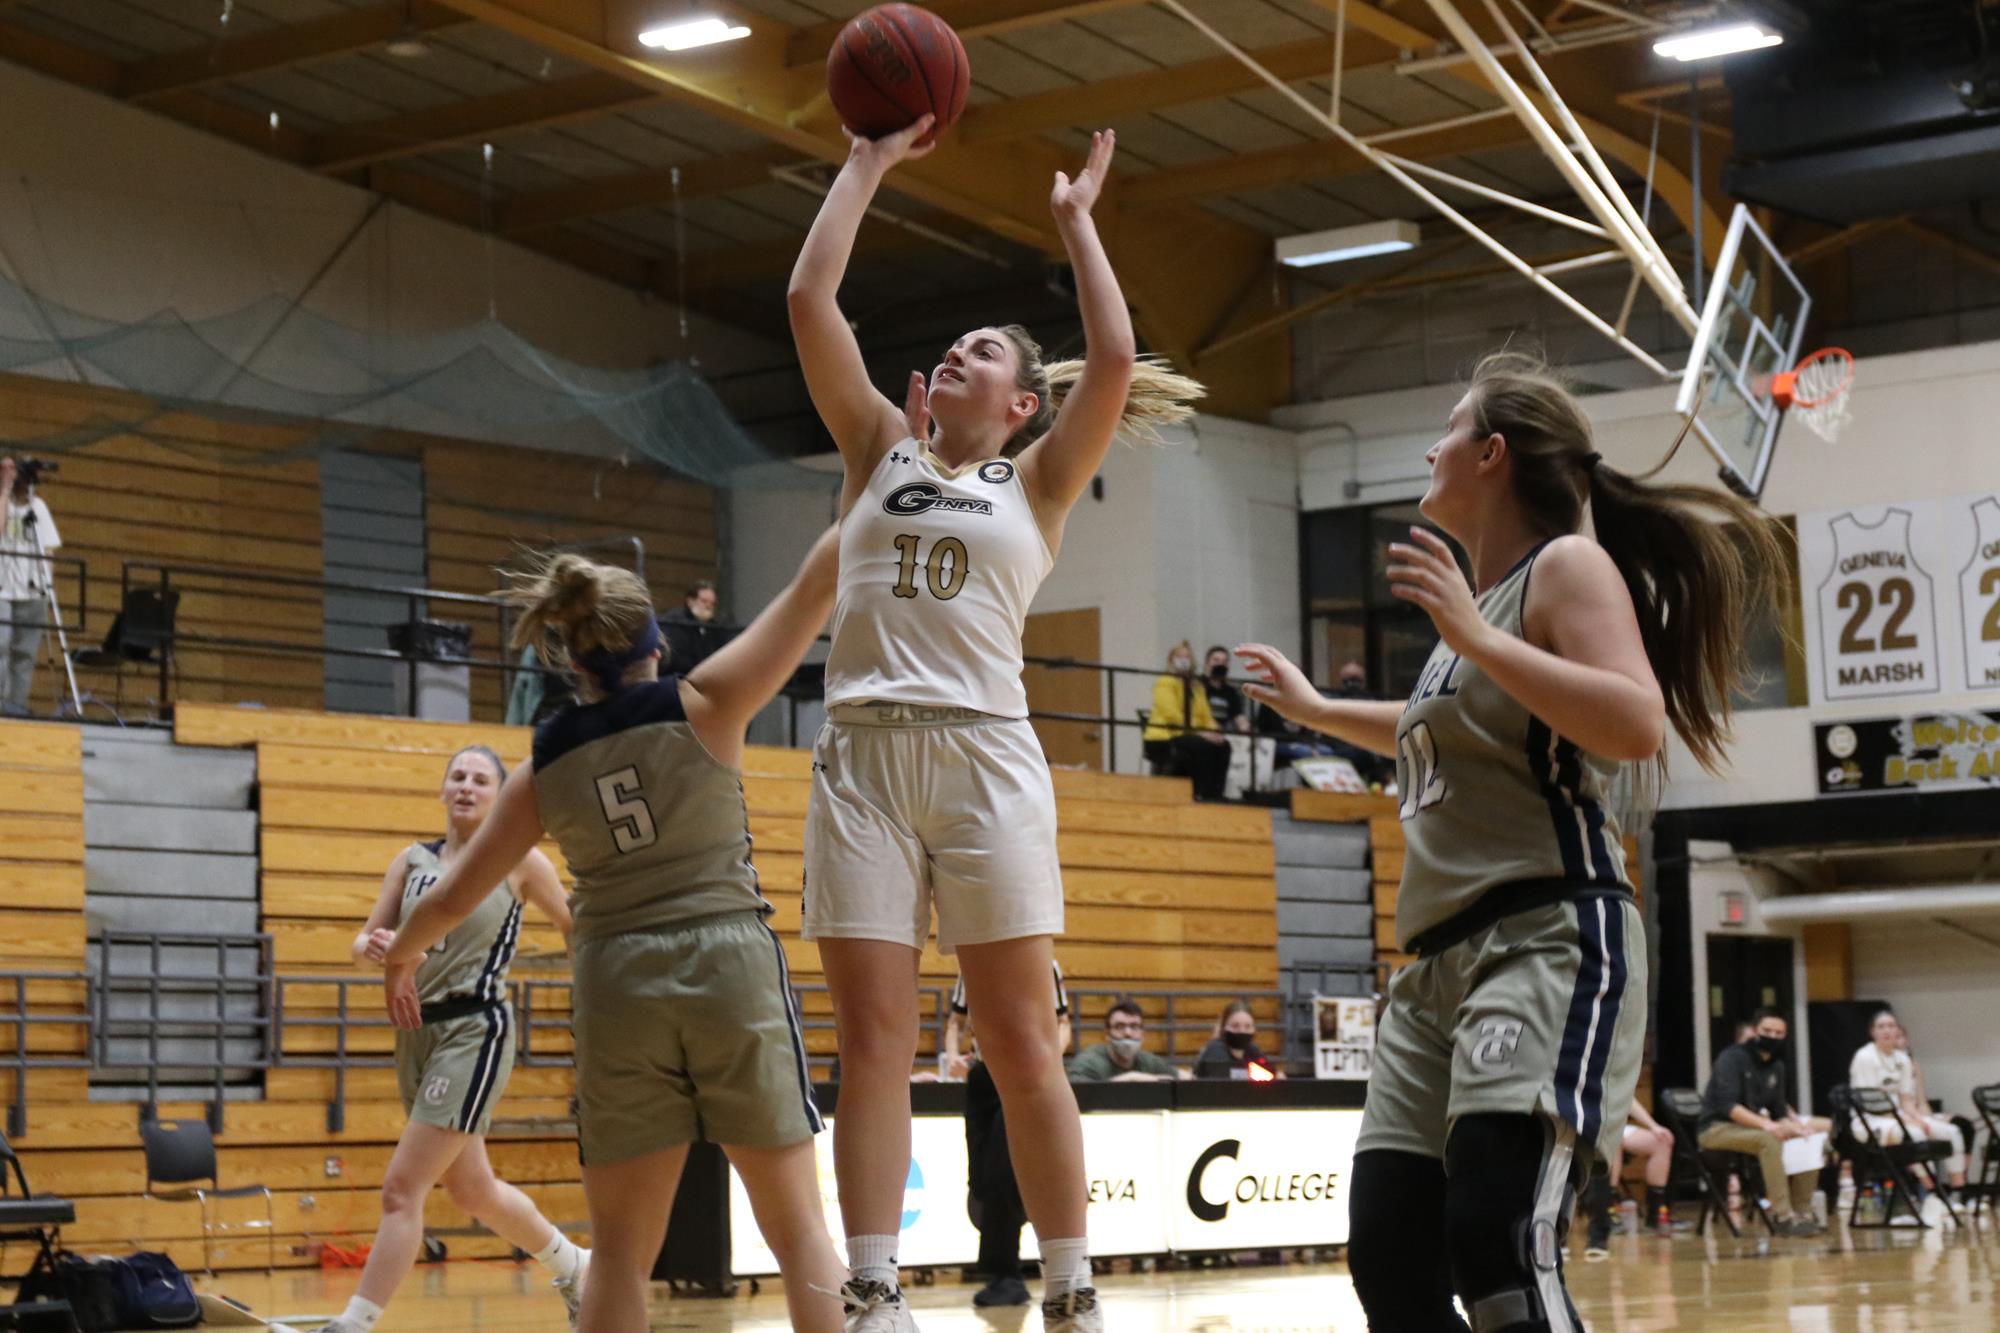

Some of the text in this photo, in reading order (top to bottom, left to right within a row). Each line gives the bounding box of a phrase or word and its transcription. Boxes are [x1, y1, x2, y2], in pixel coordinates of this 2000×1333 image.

[883, 482, 992, 516] GENEVA
[892, 534, 970, 600] 10
[1840, 551, 1906, 575] GENEVA
[1837, 576, 1918, 655] 22
[1979, 566, 2000, 642] 2
[1838, 662, 1924, 686] MARSH
[1912, 719, 2000, 749] Welco
[593, 764, 658, 854] 5
[1088, 1138, 1338, 1223] EVA COLLEGE
